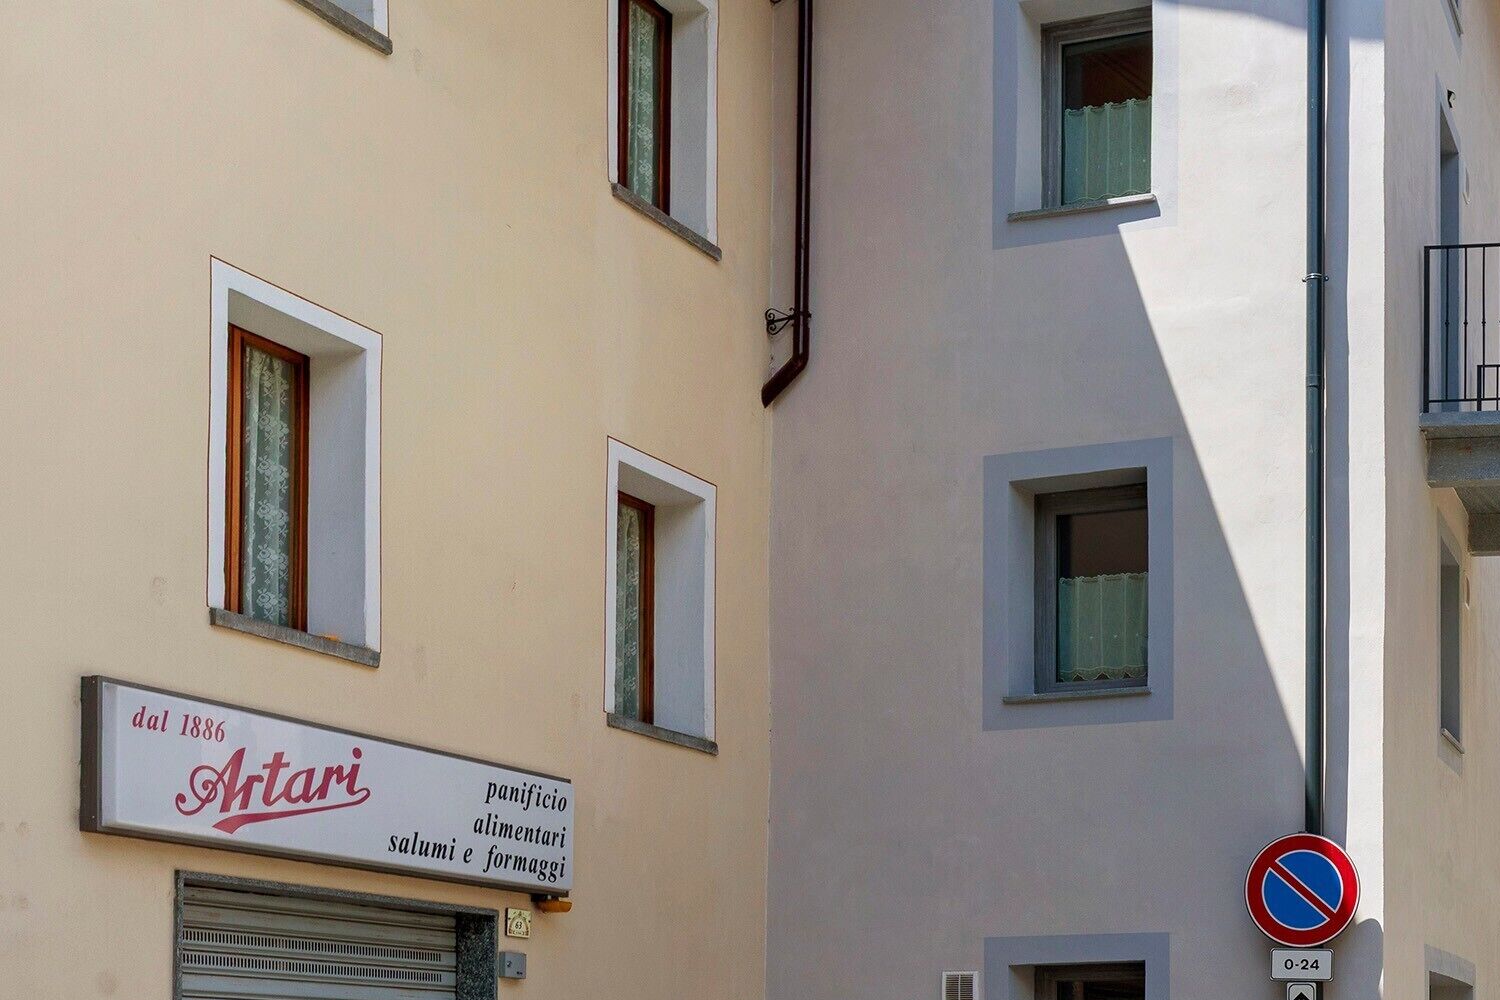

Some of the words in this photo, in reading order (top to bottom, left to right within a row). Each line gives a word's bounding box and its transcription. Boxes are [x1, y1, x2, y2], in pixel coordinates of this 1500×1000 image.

[132, 706, 169, 732] dal
[179, 713, 226, 743] 1886
[175, 747, 371, 834] Artari
[484, 781, 567, 812] panificio
[473, 813, 566, 848] alimentari
[388, 832, 456, 861] salumi
[463, 846, 473, 864] e
[483, 845, 566, 883] formaggi
[1284, 958, 1320, 971] 0-24
